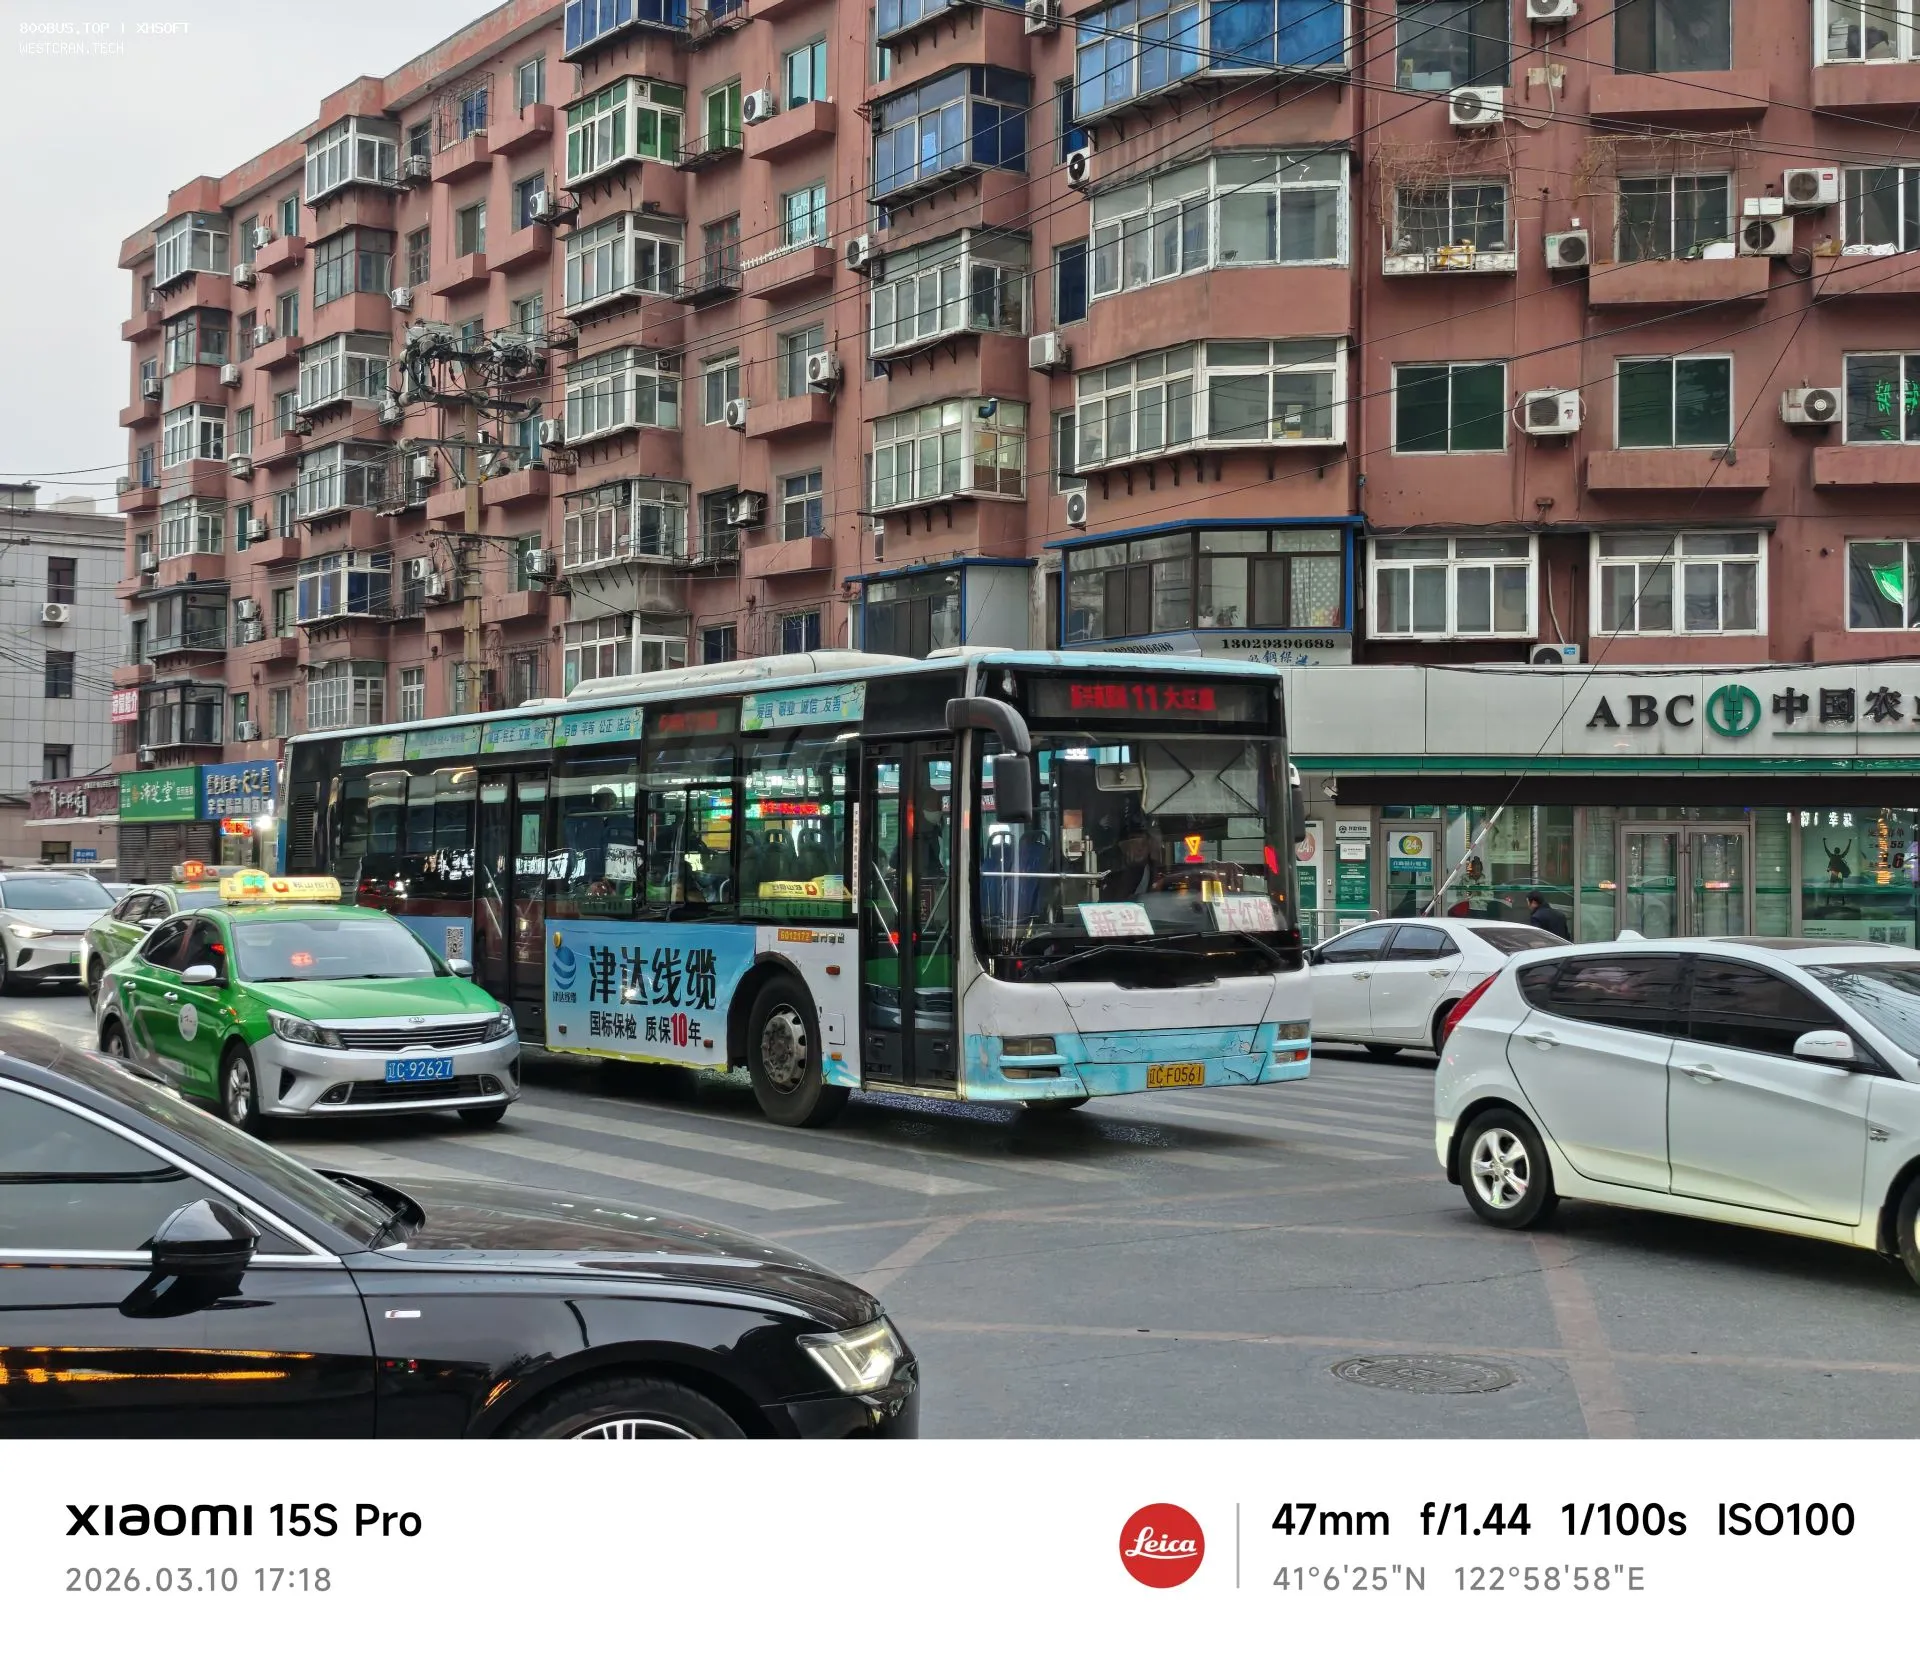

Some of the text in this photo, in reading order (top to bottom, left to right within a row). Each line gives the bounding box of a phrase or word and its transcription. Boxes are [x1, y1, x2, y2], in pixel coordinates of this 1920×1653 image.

[1221, 638, 1335, 649] 13029396688
[823, 695, 841, 712] 友善
[1586, 694, 1694, 728] ABC
[1771, 686, 1920, 724] 中国农
[581, 721, 595, 736] 平等
[589, 945, 717, 1010] 津达线缆
[589, 1010, 702, 1048] 国标保检 质保10年
